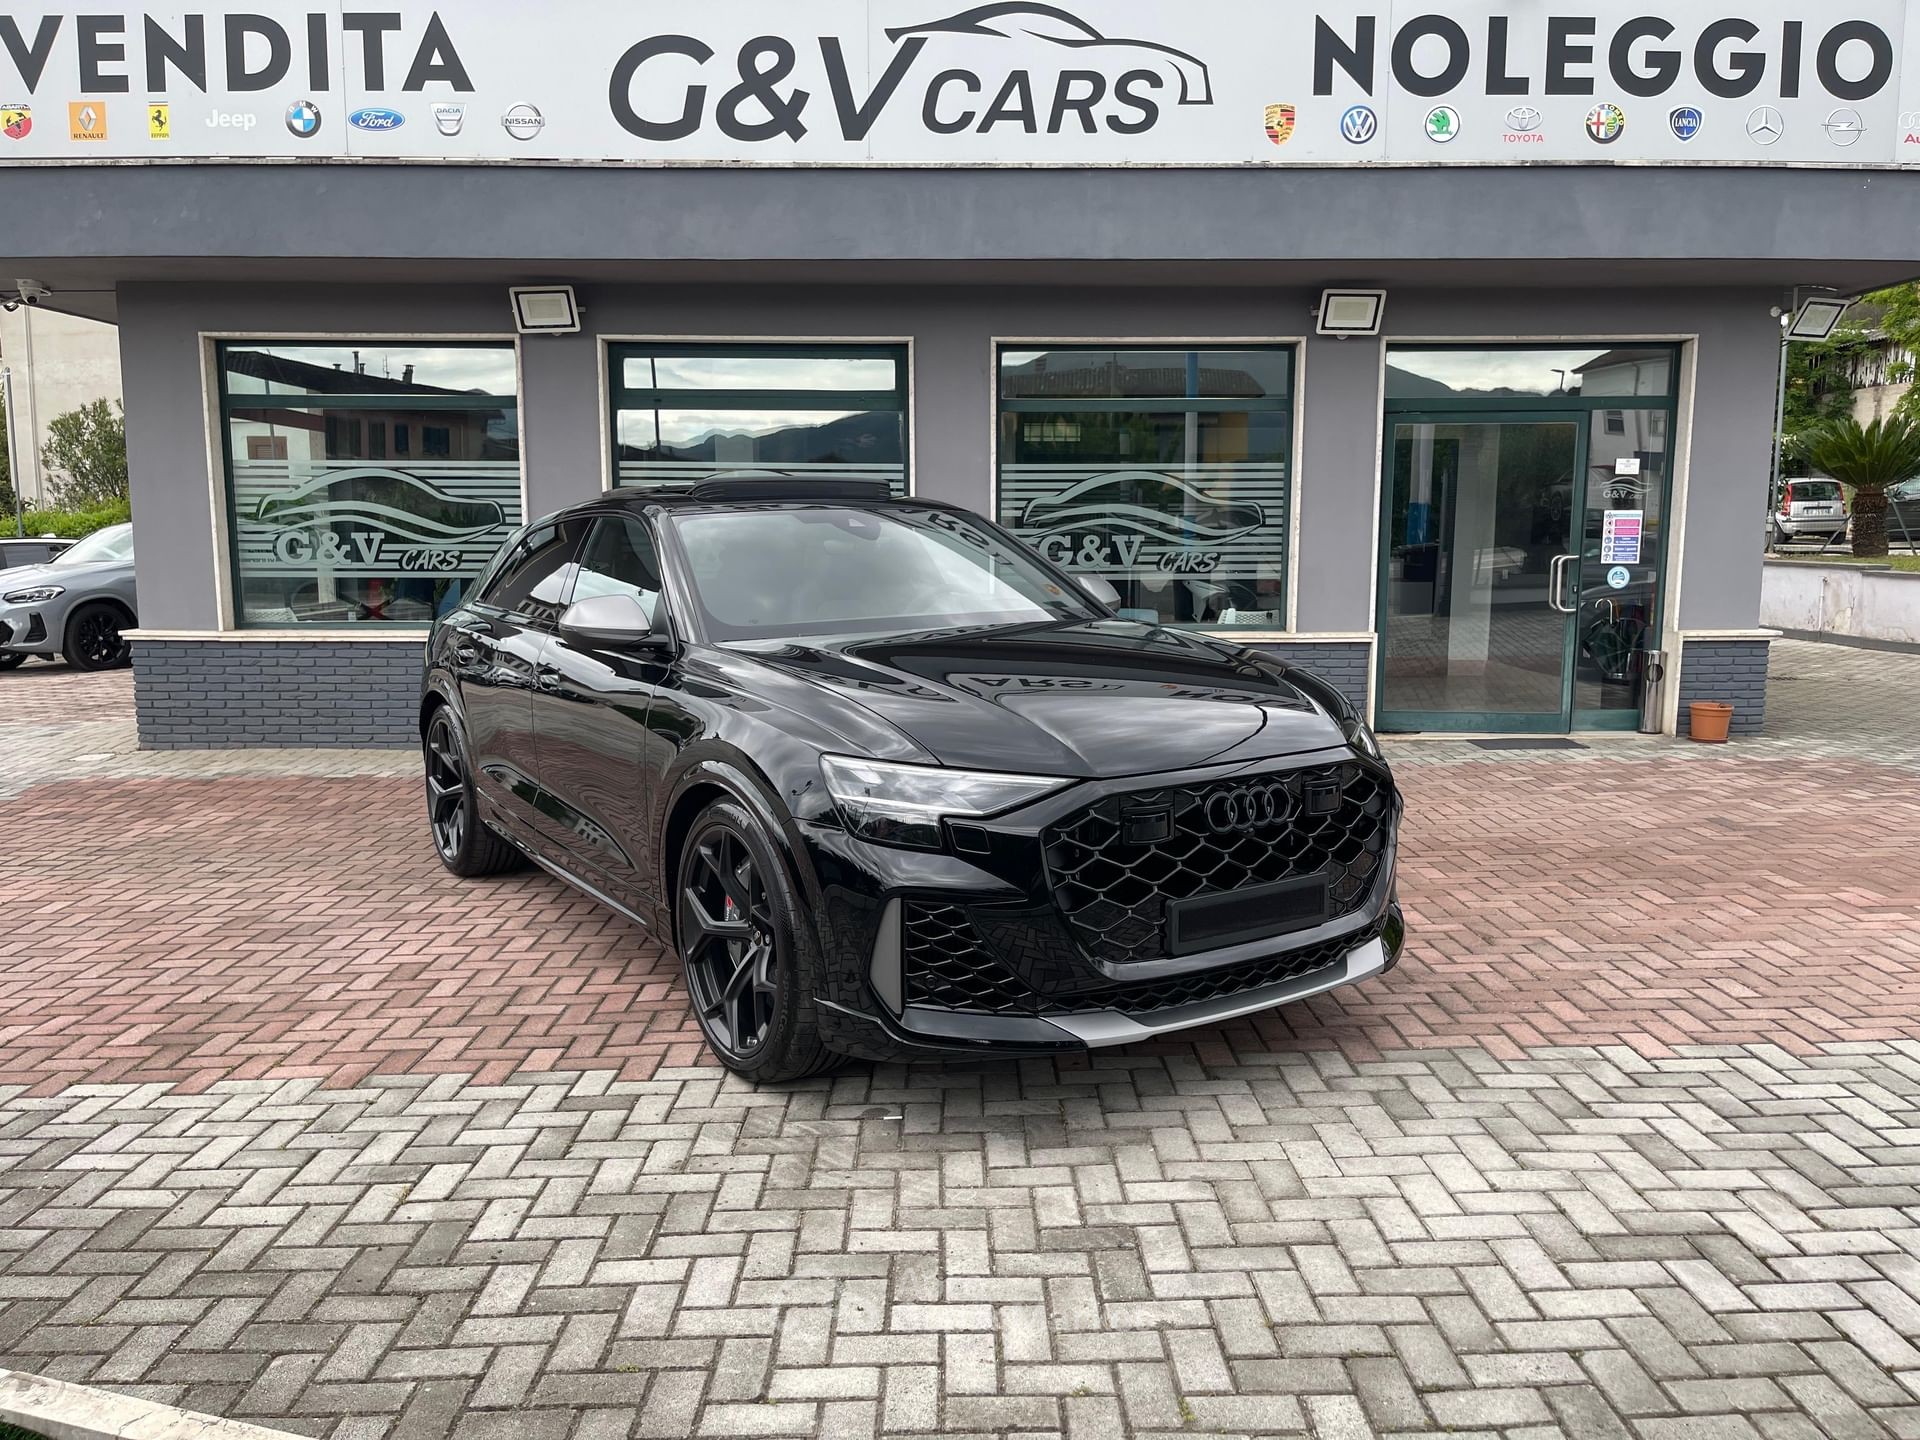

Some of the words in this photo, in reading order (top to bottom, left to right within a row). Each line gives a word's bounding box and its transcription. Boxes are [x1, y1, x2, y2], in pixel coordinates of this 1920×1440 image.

[0, 11, 475, 94] VENDITA
[1313, 14, 1894, 100] NOLEGGIO
[608, 34, 929, 142] G&V
[921, 69, 1164, 135] CARS
[205, 109, 257, 131] Jeep
[358, 111, 395, 128] Ford
[1502, 134, 1544, 143] TOYOTA
[1675, 118, 1697, 128] LANCIA
[276, 531, 384, 566] G&V
[402, 550, 461, 571] CARS
[1038, 535, 1145, 569] G&V
[1160, 551, 1218, 573] CARS
